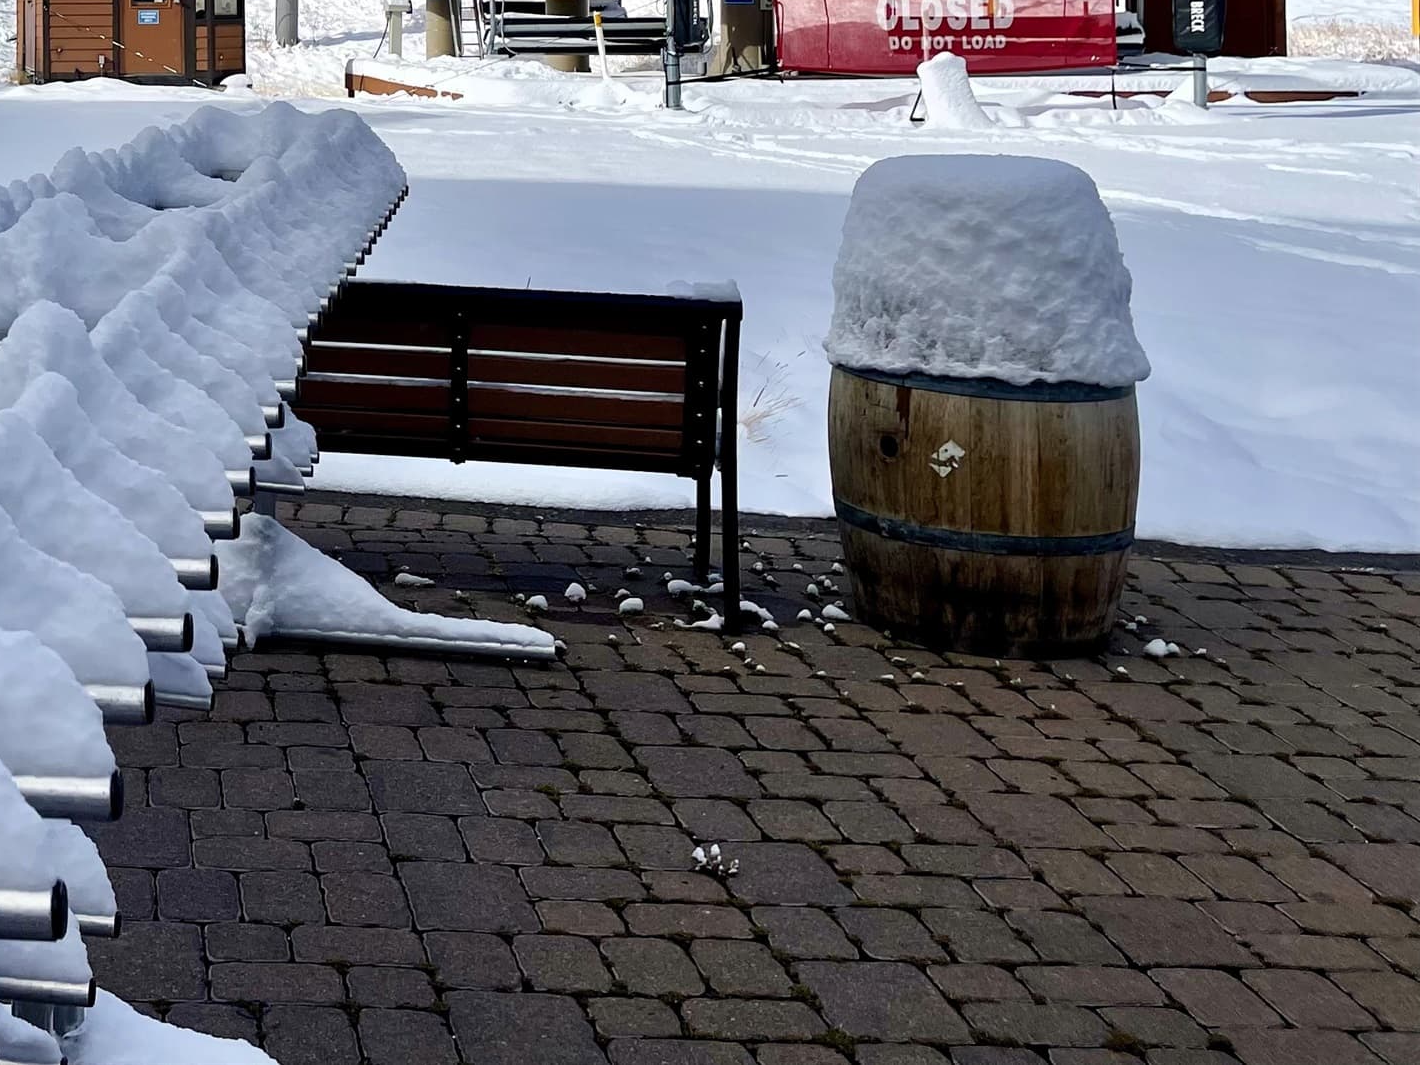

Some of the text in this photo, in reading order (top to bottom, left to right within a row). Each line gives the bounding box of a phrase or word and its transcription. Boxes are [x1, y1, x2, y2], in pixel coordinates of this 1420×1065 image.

[1190, 0, 1205, 33] BRECK
[888, 35, 1007, 50] DO NOT LOAD
